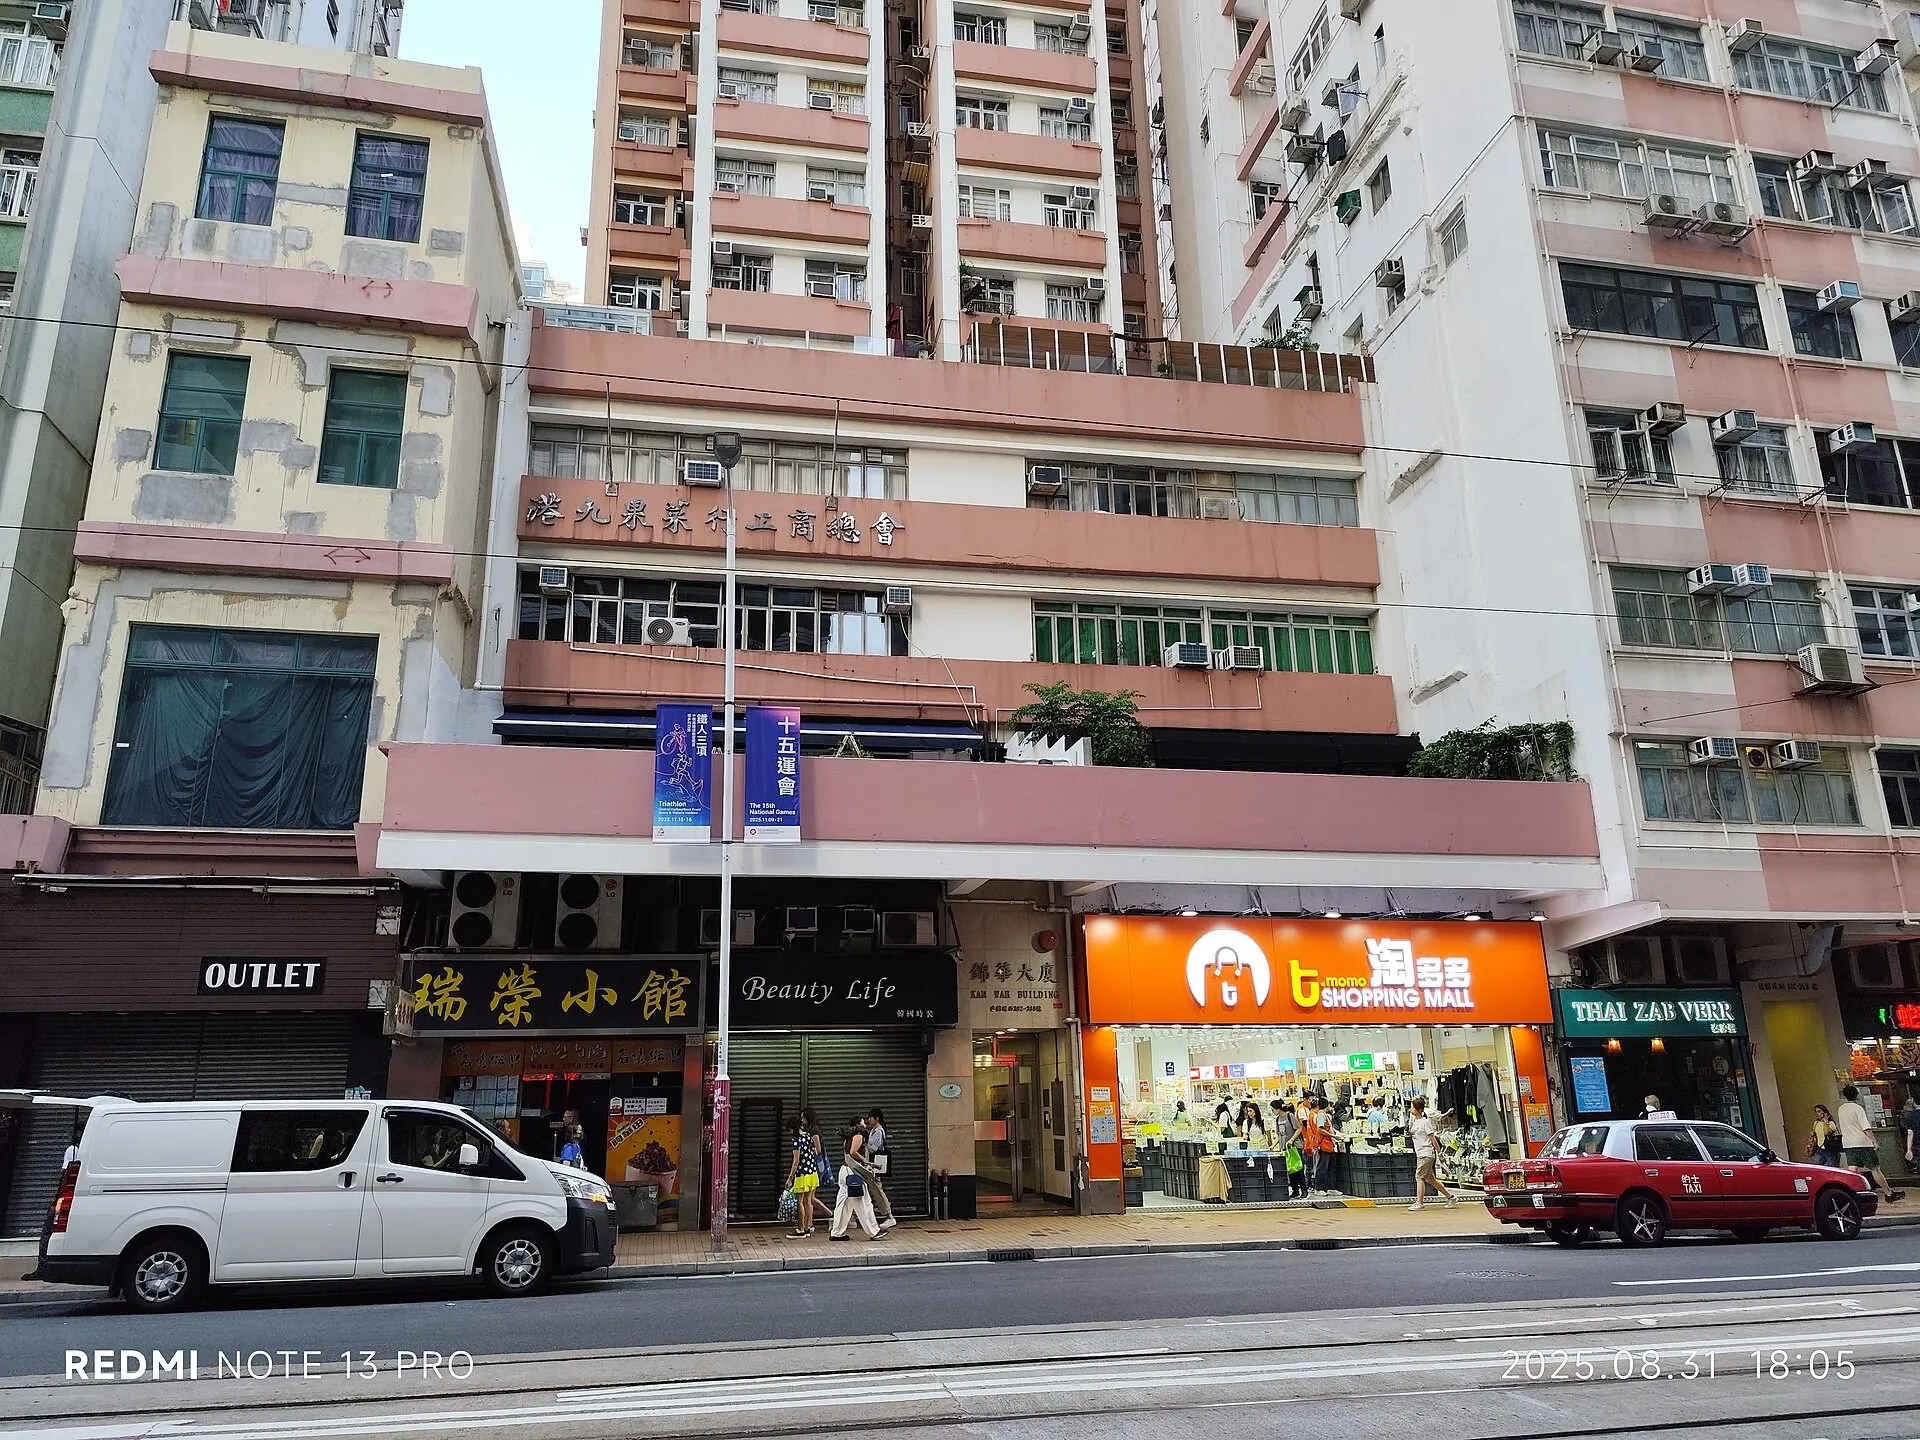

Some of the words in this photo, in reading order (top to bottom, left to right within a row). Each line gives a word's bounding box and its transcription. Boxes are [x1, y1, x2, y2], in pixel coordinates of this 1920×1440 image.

[526, 492, 905, 546] 港九果菜行工商總會
[696, 713, 708, 757] 鐵人三項
[777, 715, 796, 796] 十五運會
[502, 888, 513, 896] LG
[605, 890, 616, 898] LG
[969, 961, 1058, 984] 錦華大廈
[1364, 938, 1472, 988] 淘多多
[205, 963, 321, 988] OUTLET
[413, 963, 692, 1028] 瑞榮小館
[742, 976, 833, 1005] Beauty
[846, 977, 896, 1008] Life
[970, 990, 987, 999] KAM
[994, 990, 1010, 999] WAH
[1017, 990, 1060, 999] BUILDING
[1321, 988, 1420, 1009] SHOPPING
[1424, 988, 1475, 1008] MALL
[1571, 1001, 1628, 1022] THAI
[1633, 1001, 1677, 1022] ZAB
[1678, 1001, 1736, 1021] VERR
[1681, 1174, 1700, 1185] 的士
[1683, 1183, 1703, 1194] TAXI
